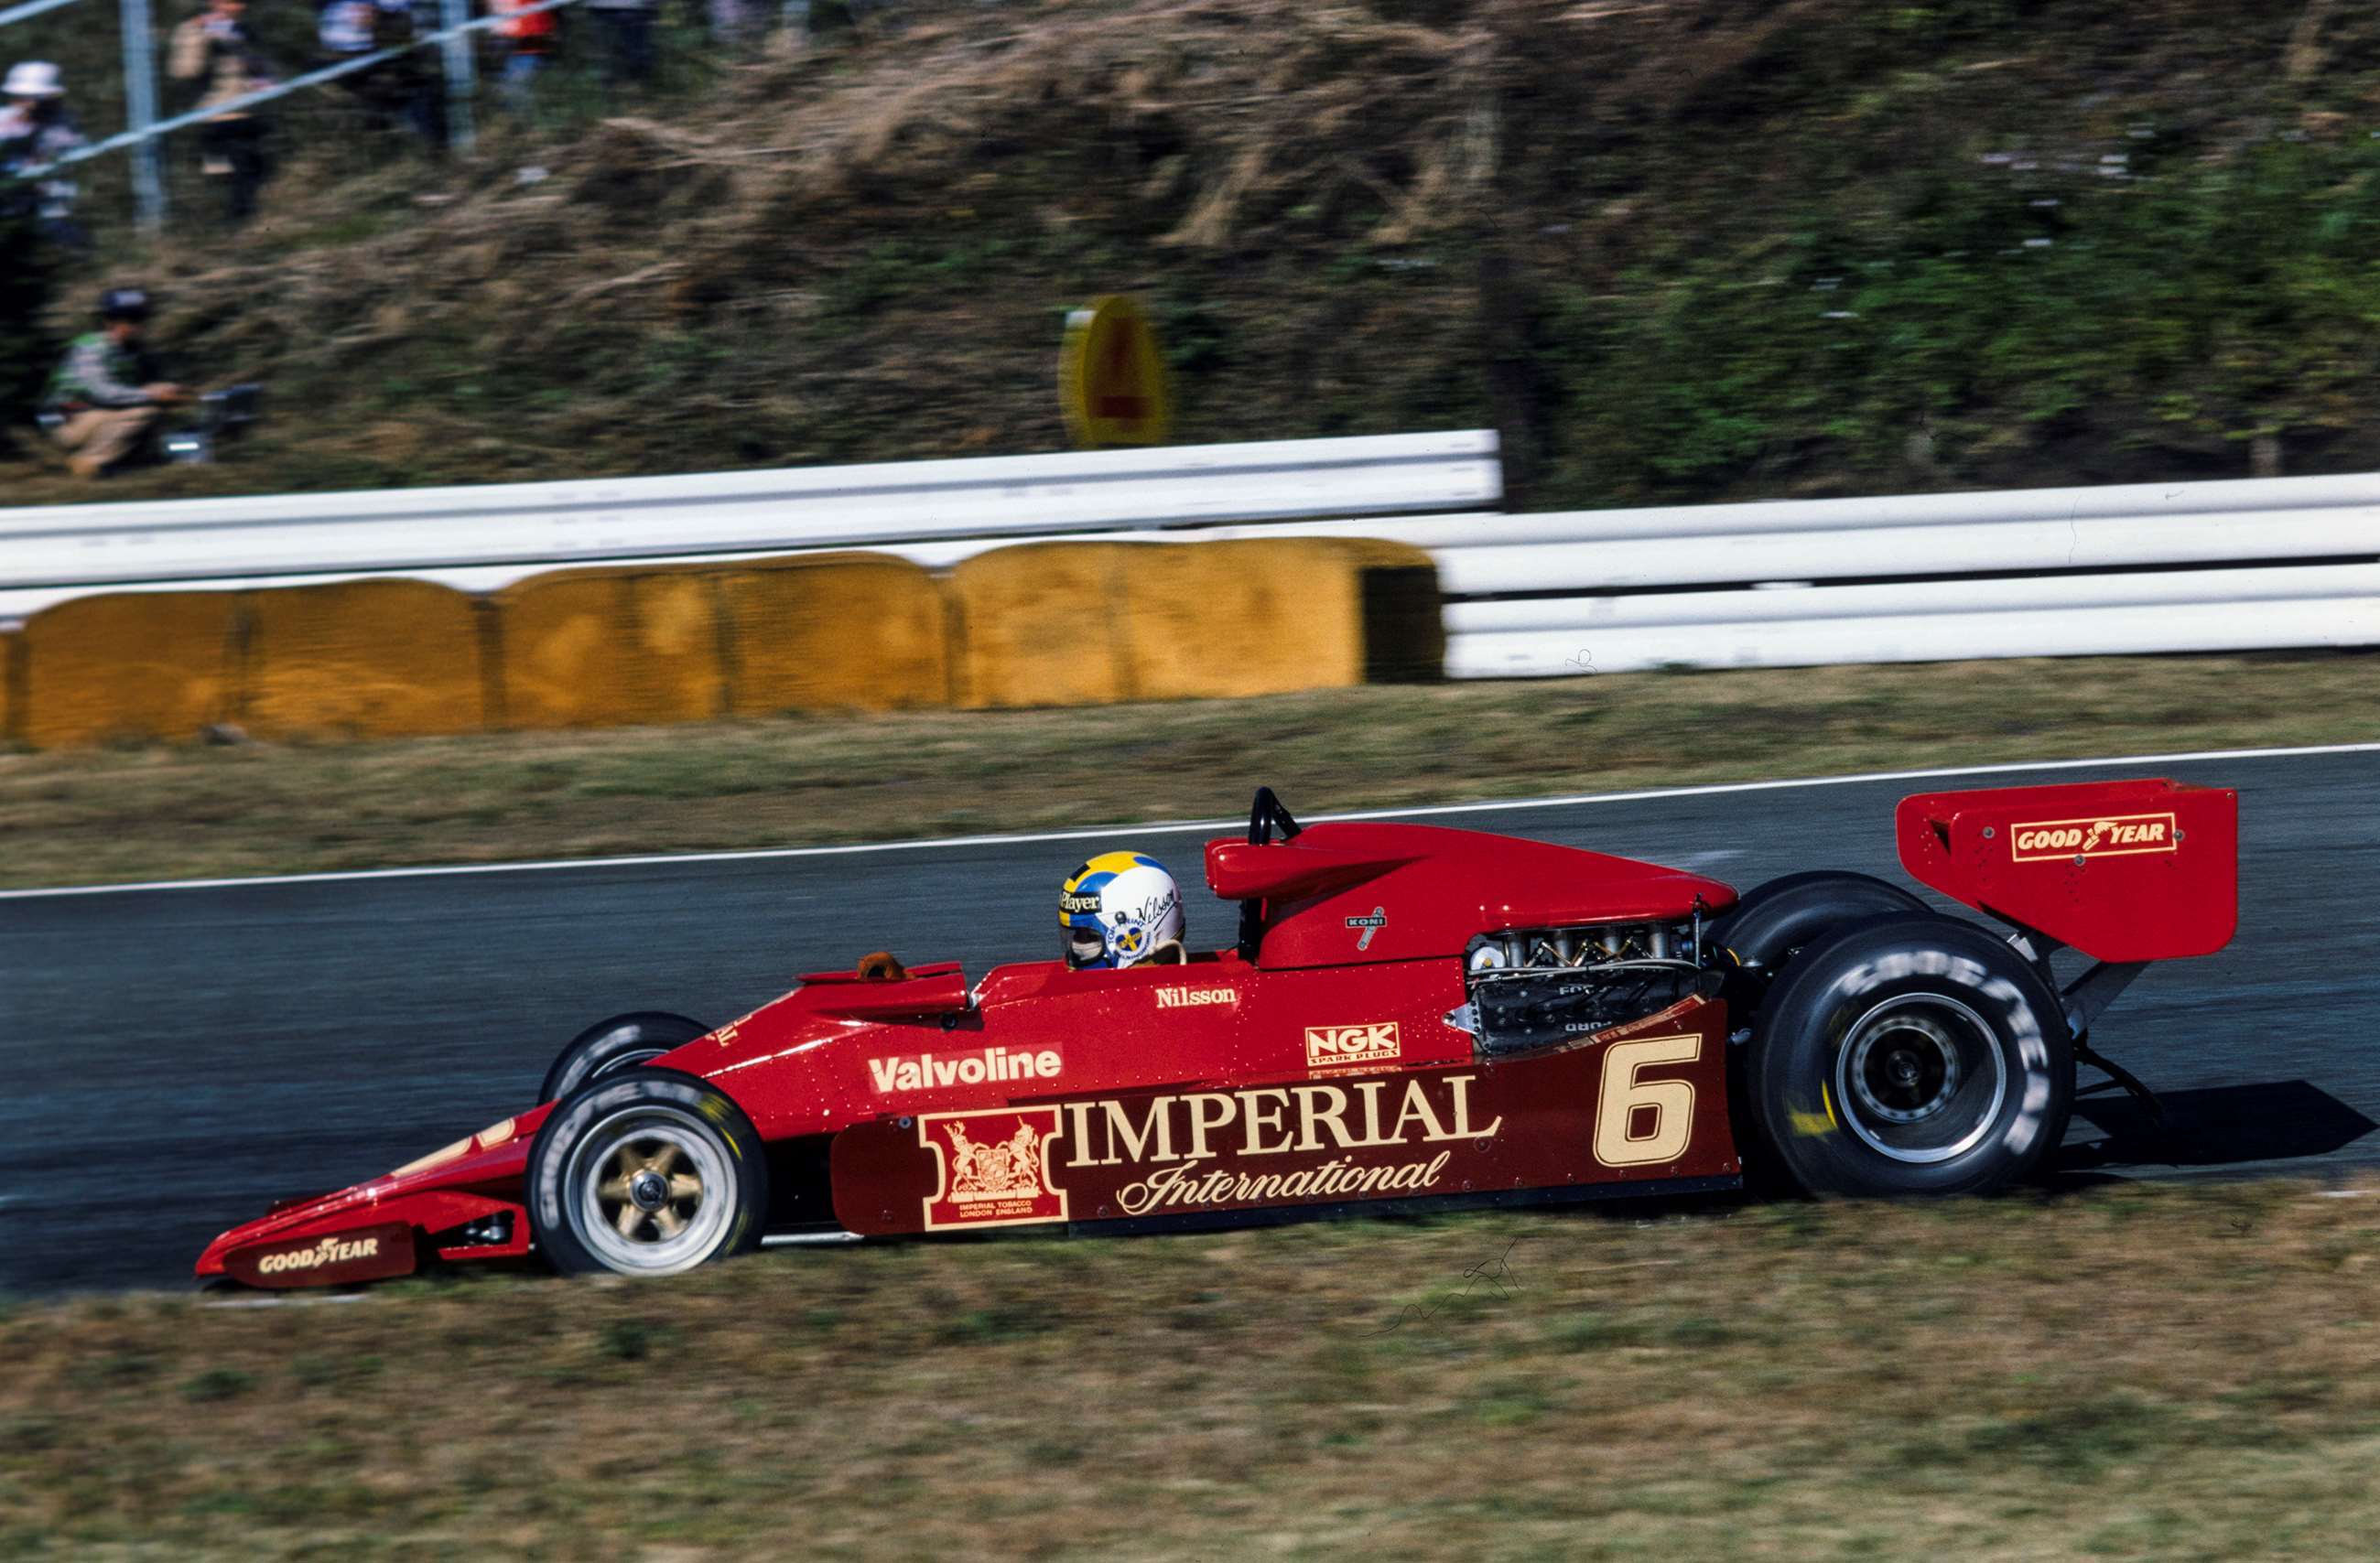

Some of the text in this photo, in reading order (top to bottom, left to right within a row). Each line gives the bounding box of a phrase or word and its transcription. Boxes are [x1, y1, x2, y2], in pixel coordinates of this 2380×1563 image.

[2018, 823, 2166, 850] GOOD YEAR
[1348, 918, 1383, 926] KONI
[1155, 986, 1237, 1008] Nilsson
[1308, 1025, 1397, 1057] NGK
[869, 1047, 1062, 1093] Valvoline
[1310, 1050, 1398, 1063] SPARK PLUGS
[1593, 1033, 1704, 1167] 6
[1065, 1075, 1502, 1167] IMPERIAL
[1117, 1150, 1451, 1215] International
[959, 1200, 1032, 1211] IMPERIAL TOBACCO
[959, 1207, 1033, 1218] LONDON ENGLAND
